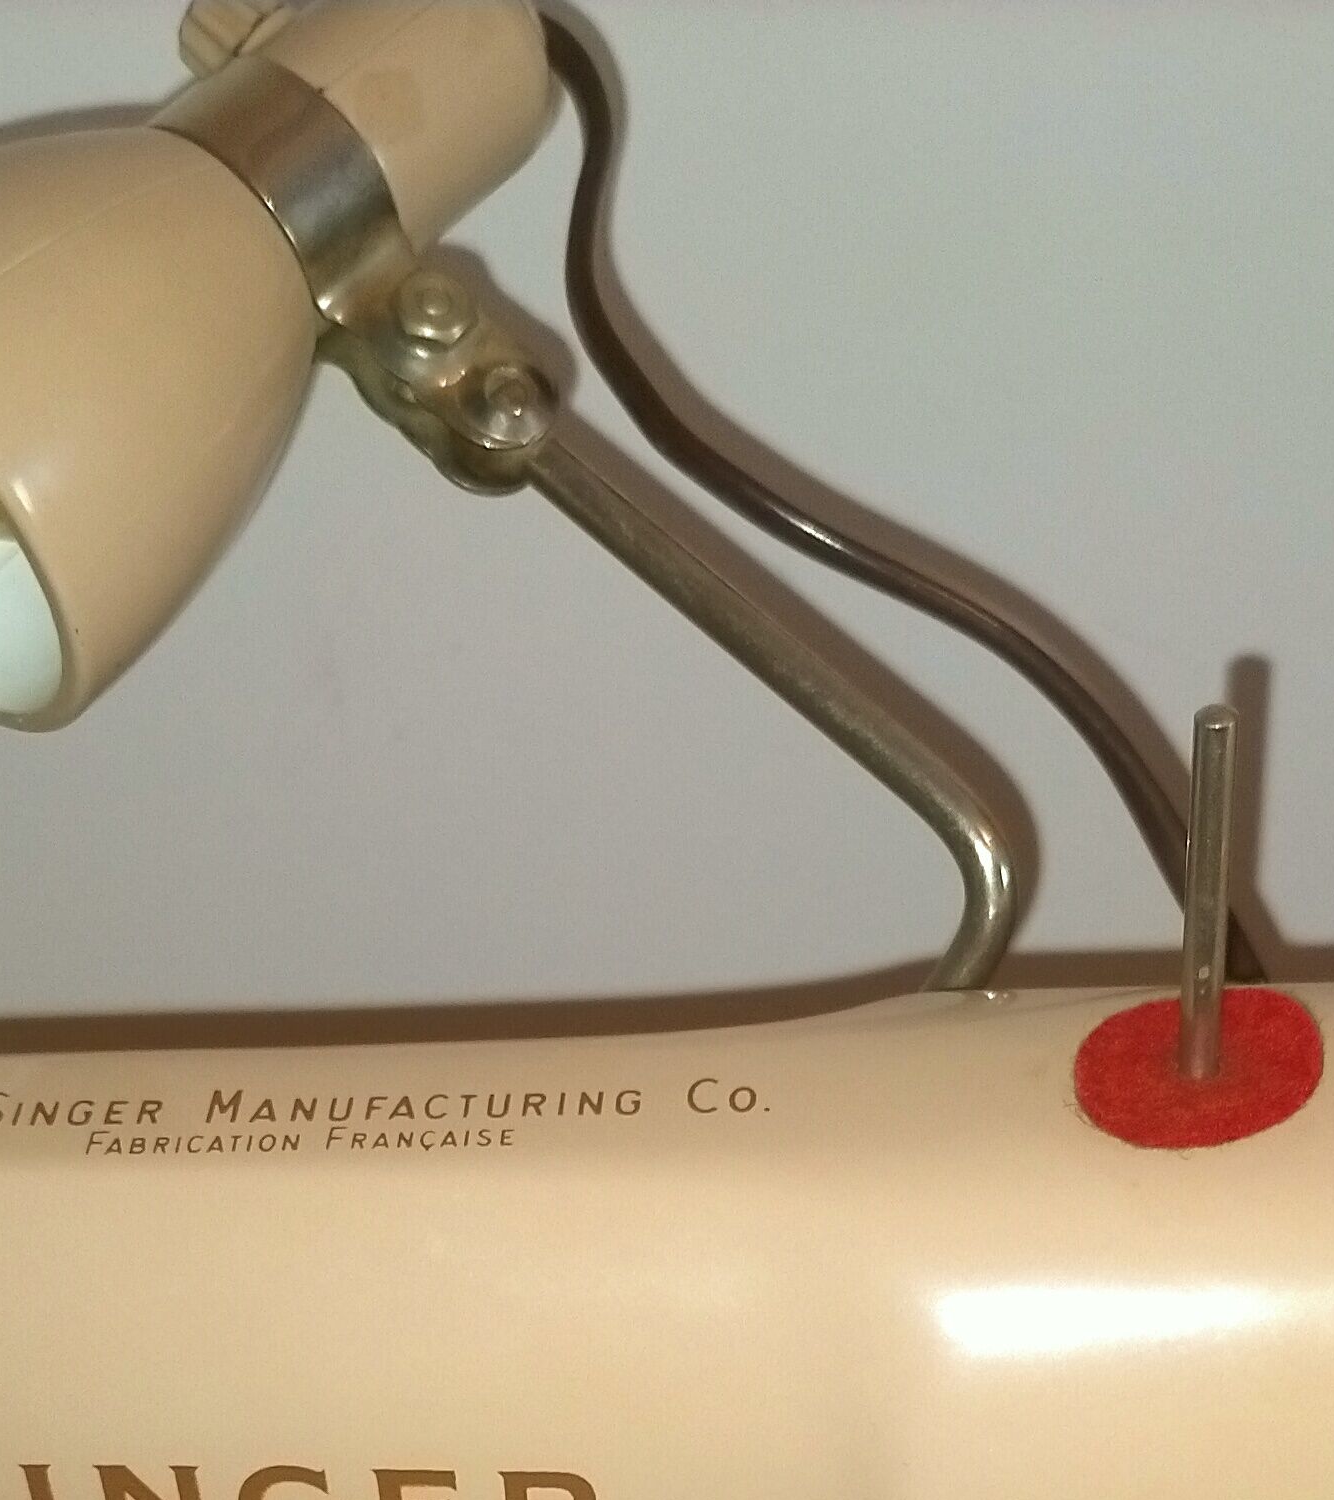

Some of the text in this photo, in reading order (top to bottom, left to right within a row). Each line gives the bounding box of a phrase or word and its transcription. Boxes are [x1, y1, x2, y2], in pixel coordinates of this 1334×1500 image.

[205, 1089, 642, 1124] MANUFACTURING
[85, 1126, 516, 1156] FABRICATION FRANÇAISE
